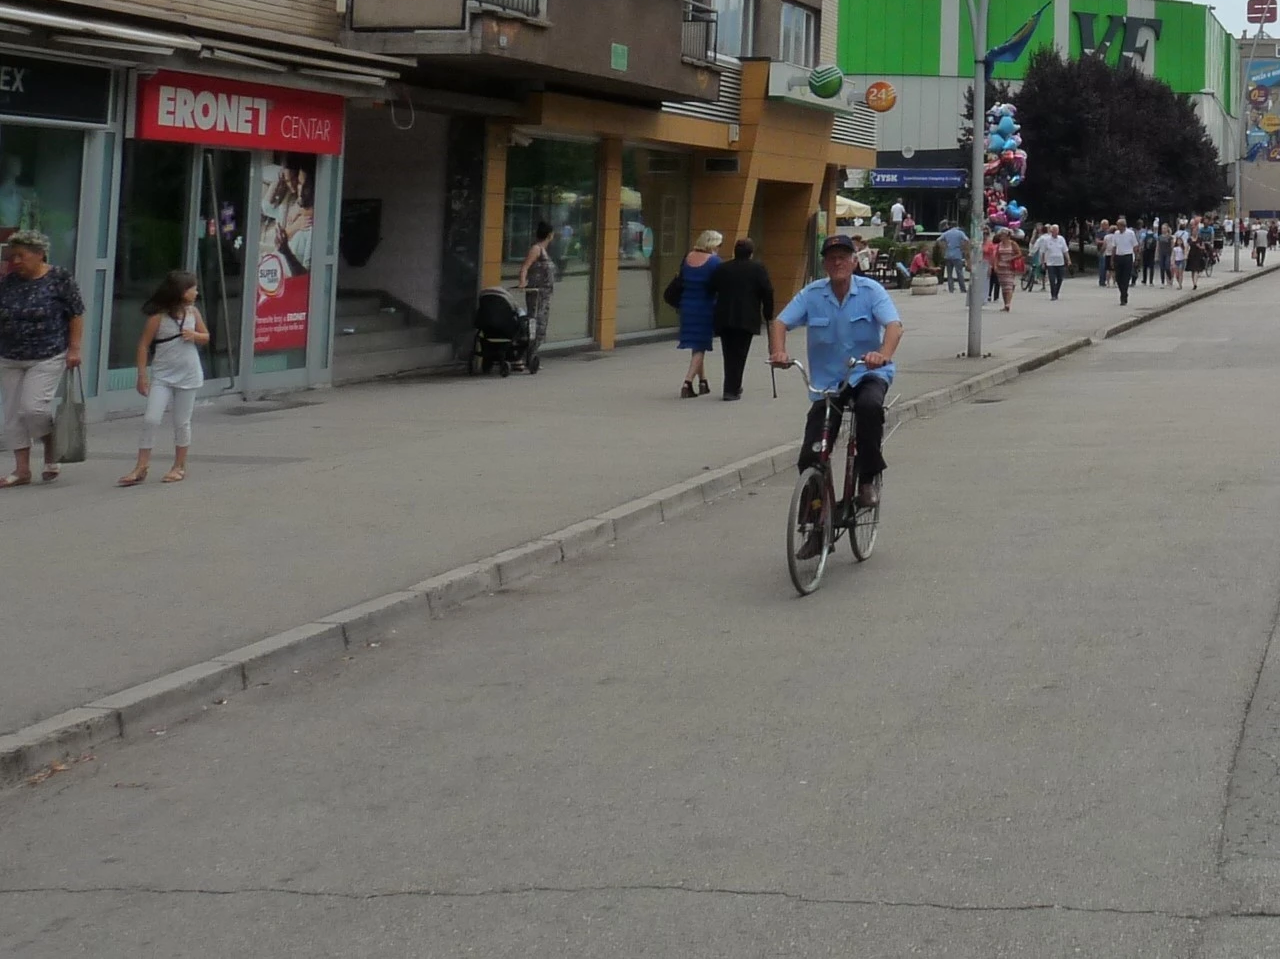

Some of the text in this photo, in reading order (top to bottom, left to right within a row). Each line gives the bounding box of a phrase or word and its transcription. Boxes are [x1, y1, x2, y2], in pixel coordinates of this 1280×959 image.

[869, 88, 887, 100] 24
[157, 85, 331, 141] ERONET CENTAR
[875, 174, 898, 182] JYSK
[259, 268, 278, 278] SUPER
